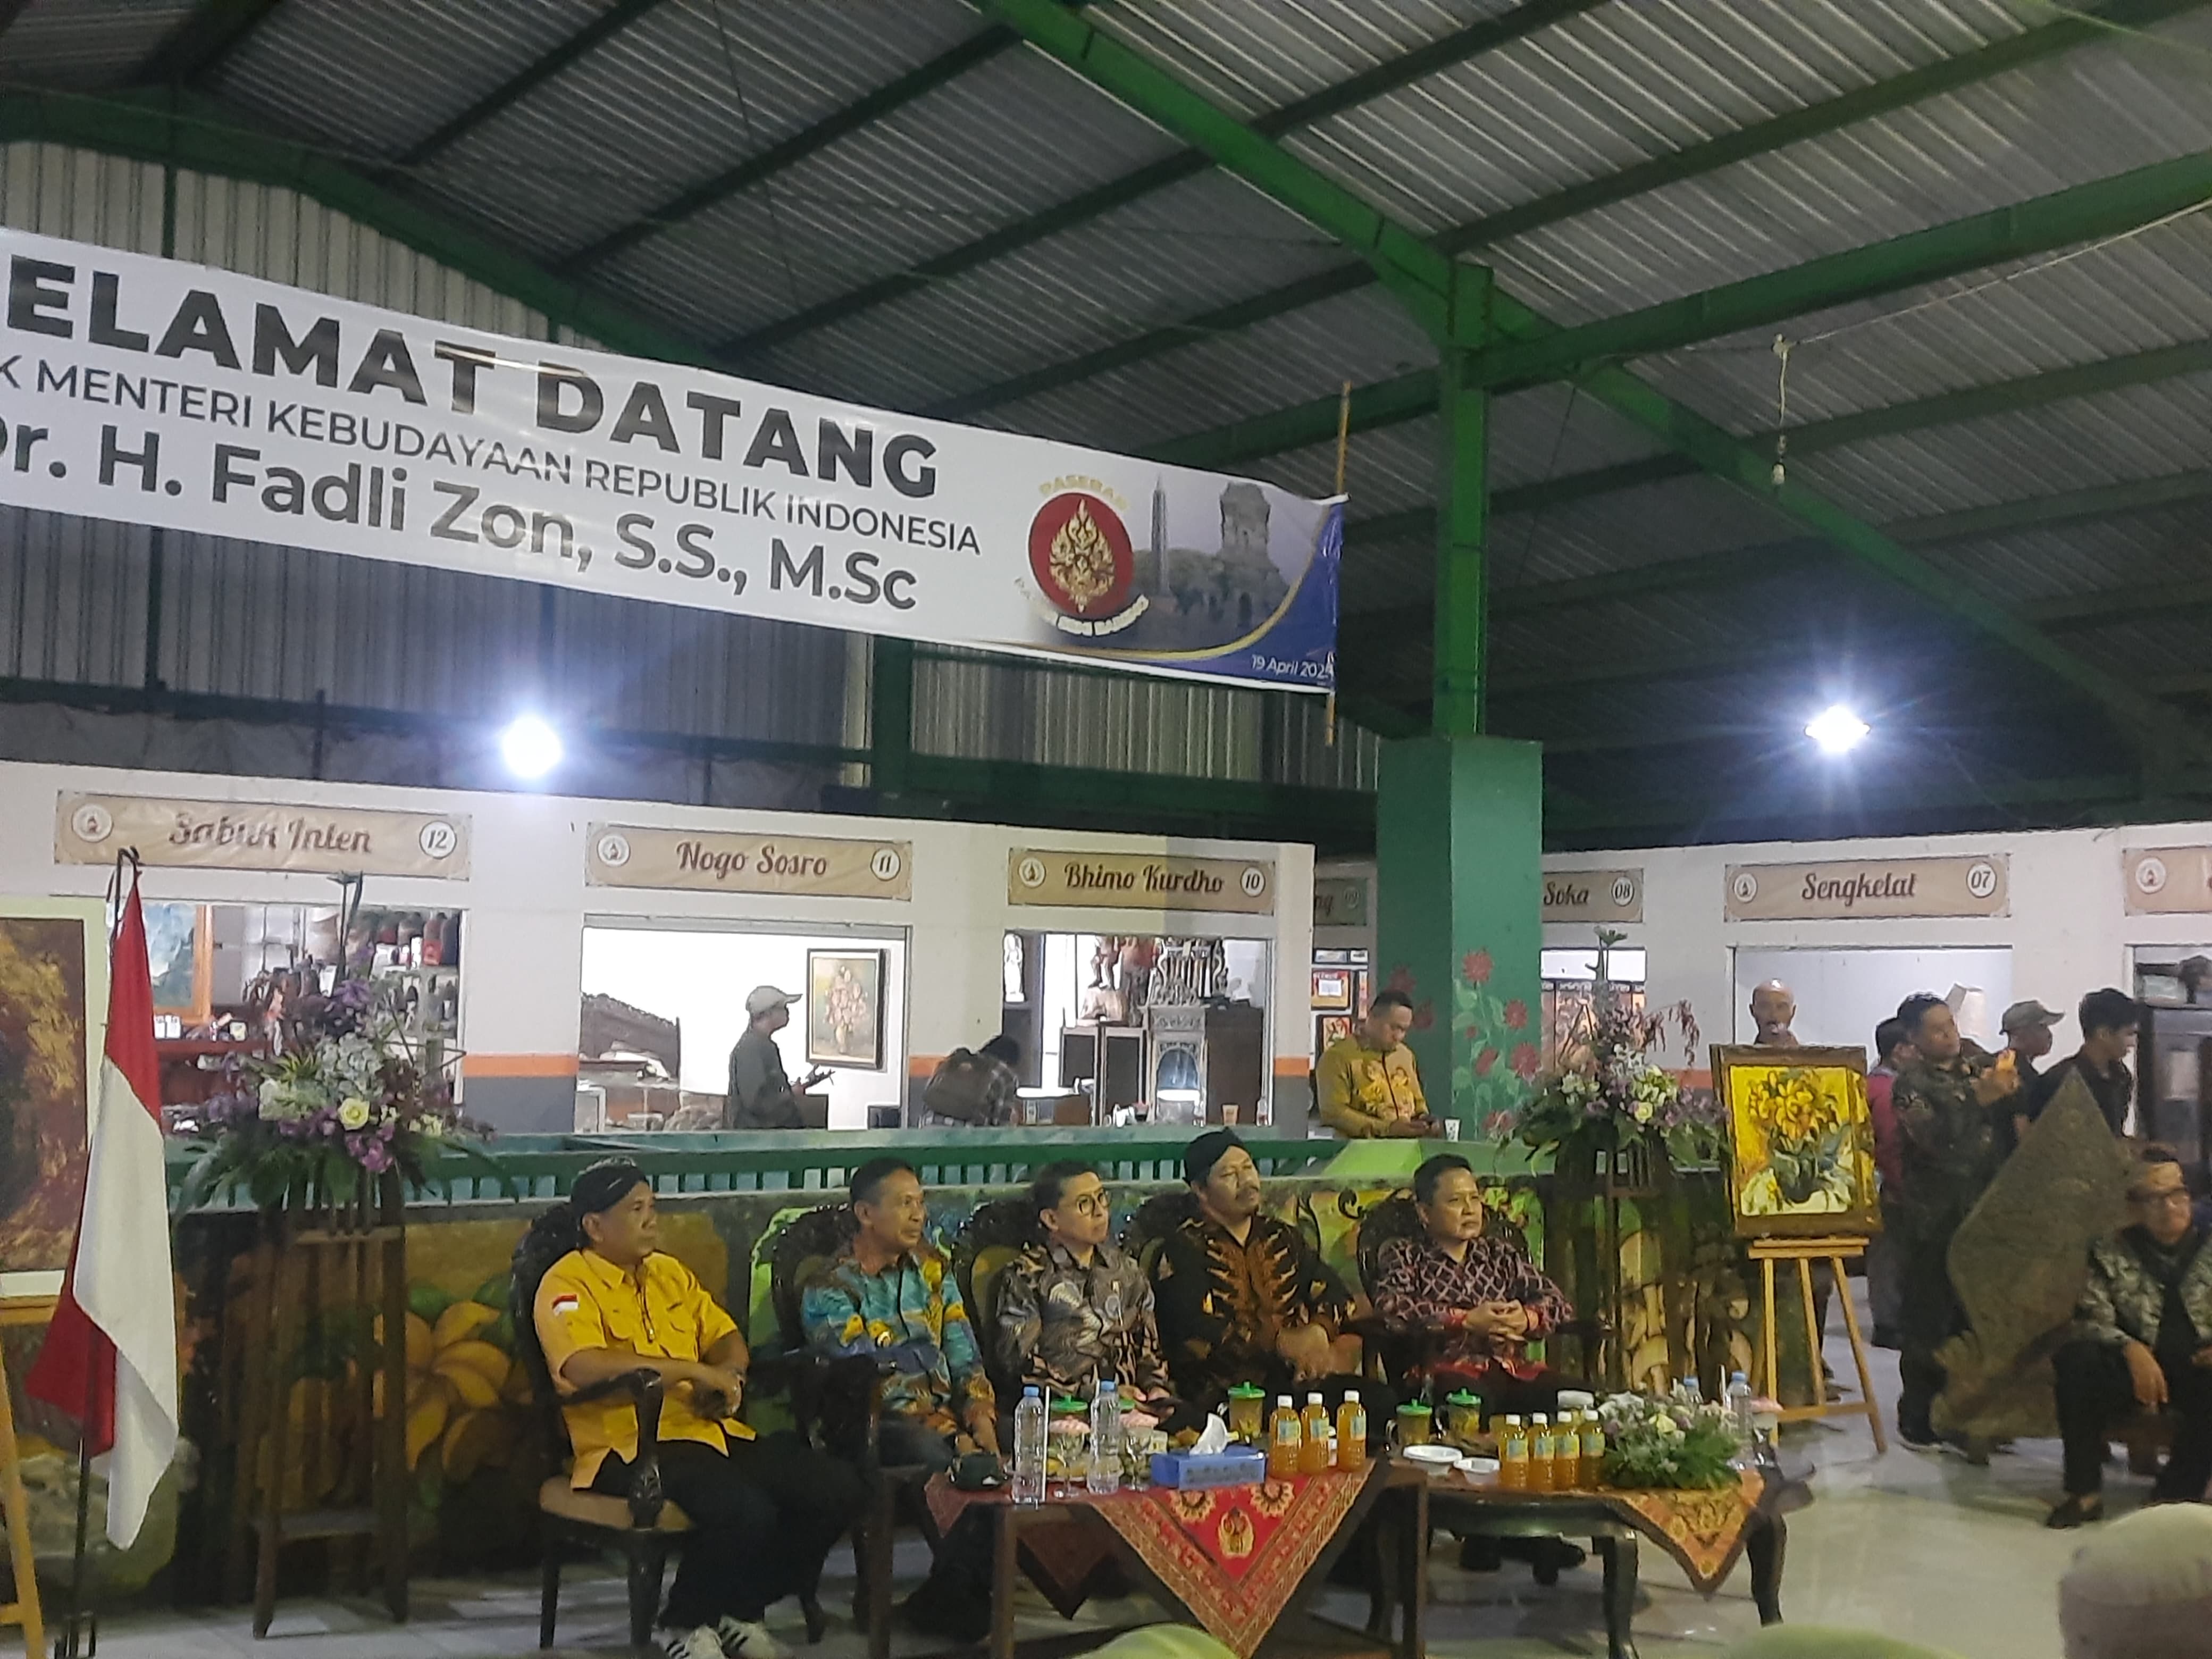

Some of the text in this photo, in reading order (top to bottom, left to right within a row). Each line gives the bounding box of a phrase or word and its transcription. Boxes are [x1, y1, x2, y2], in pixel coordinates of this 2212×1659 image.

[536, 361, 936, 498] DATANG
[37, 359, 251, 428] MENTERI
[268, 400, 571, 484] KEBUDAYAAN
[585, 459, 776, 521] REPUBLIK
[787, 494, 980, 555] INDONESIA
[0, 417, 917, 609] r. H. Fadli Zon, S.S., M.Sc
[1252, 653, 1266, 670] 19
[1266, 657, 1298, 676] April
[427, 830, 448, 850] 12
[676, 841, 892, 879] Nogo Sosro 11
[1065, 862, 1260, 893] Bhimo Kurdho 10
[1544, 881, 1631, 906] Soka 08
[1802, 870, 1991, 907] Sengkelat 07
